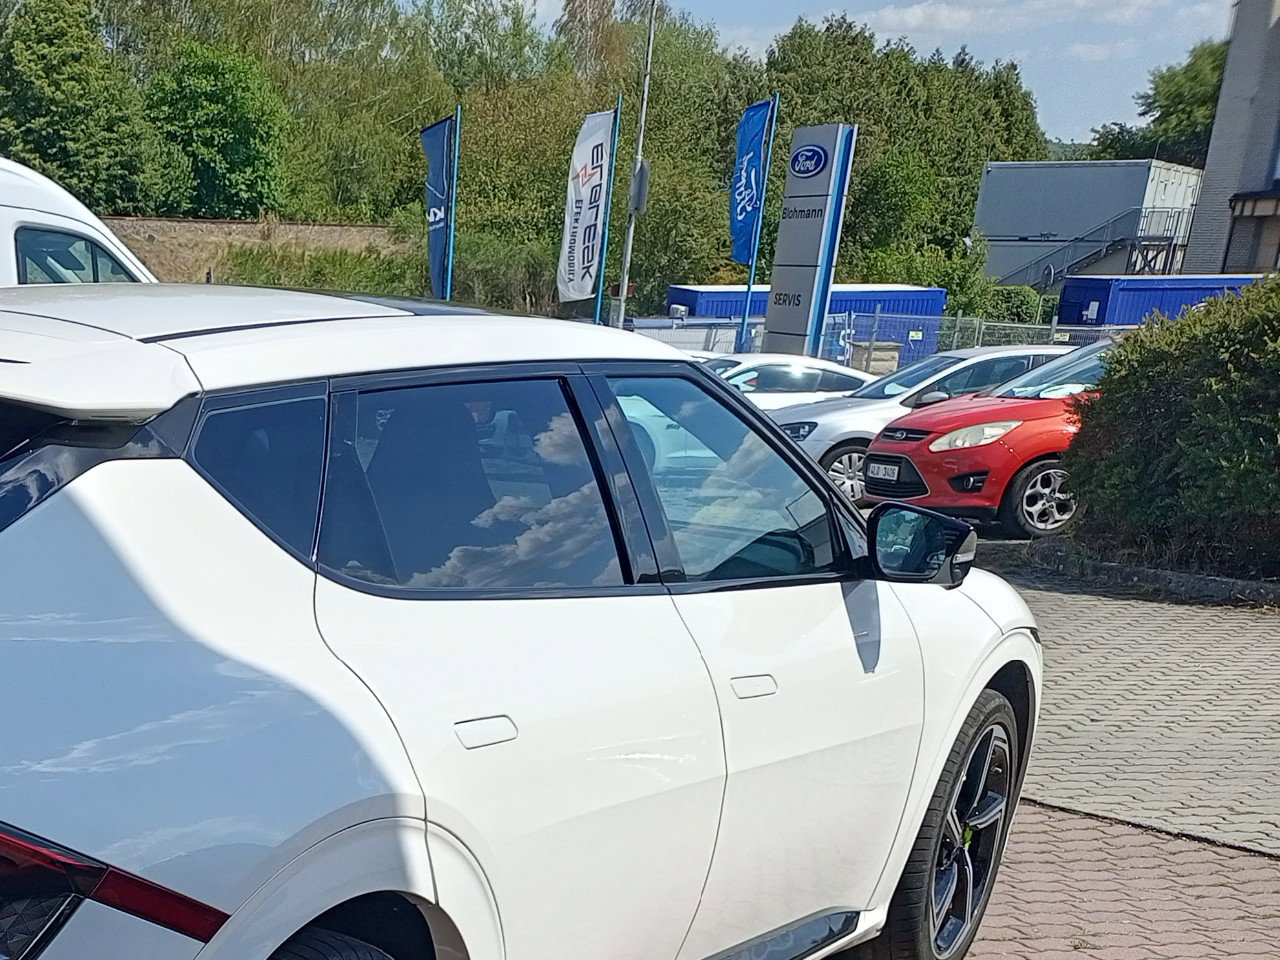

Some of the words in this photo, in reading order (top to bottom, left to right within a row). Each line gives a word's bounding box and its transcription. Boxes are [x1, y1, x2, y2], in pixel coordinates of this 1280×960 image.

[794, 151, 817, 171] Ford
[782, 207, 824, 220] Blohmann
[773, 293, 802, 307] SERVIS
